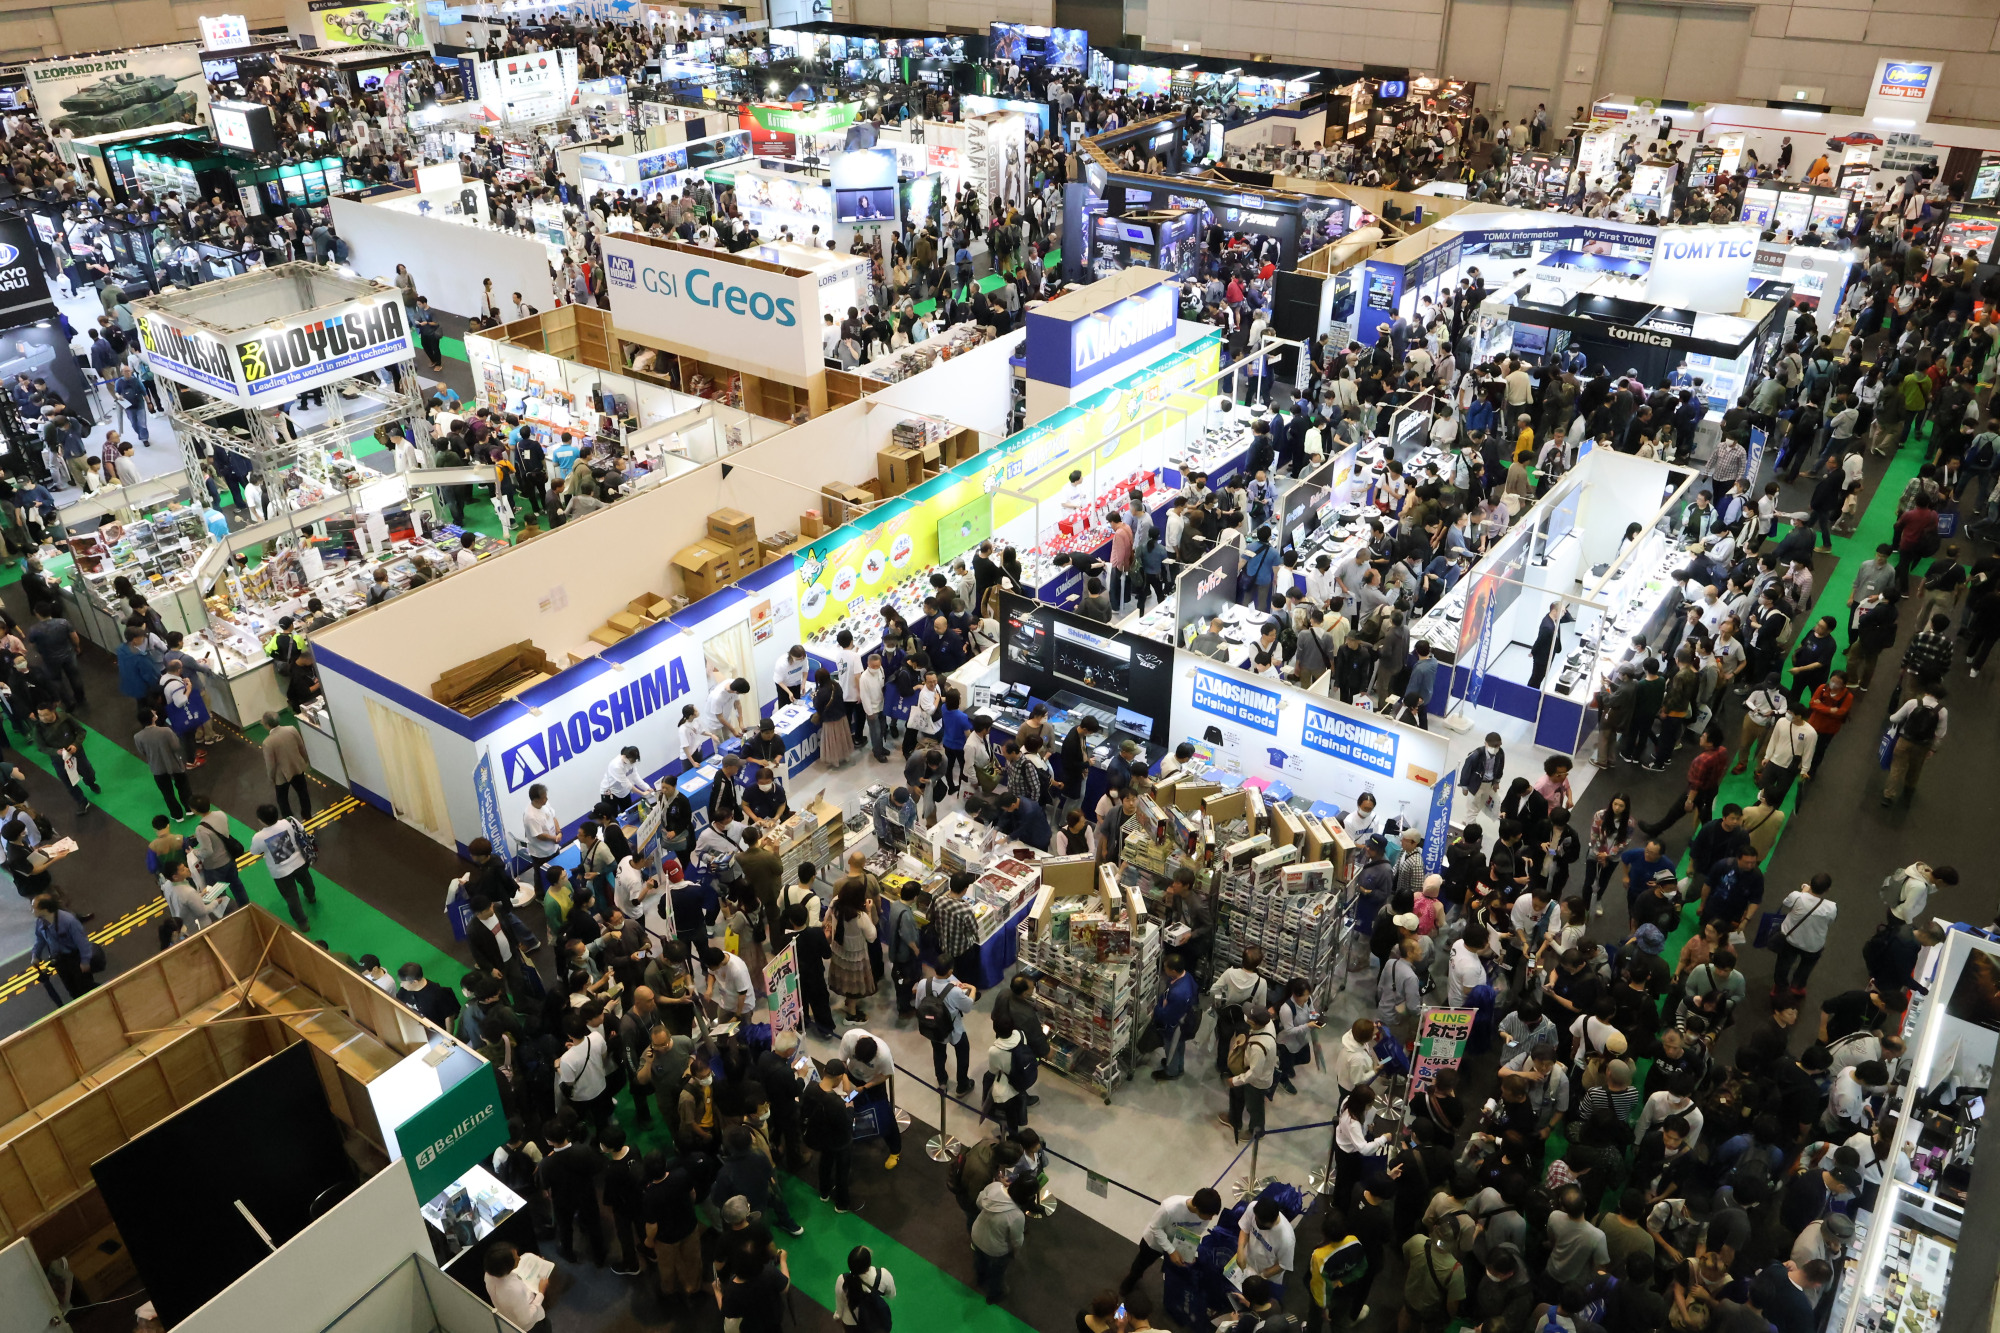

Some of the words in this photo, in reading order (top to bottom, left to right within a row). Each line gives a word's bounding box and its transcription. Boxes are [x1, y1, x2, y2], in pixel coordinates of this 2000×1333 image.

[215, 37, 243, 46] TAMIYA
[34, 63, 95, 80] LEOPARD
[95, 63, 103, 71] 2
[105, 60, 128, 71] A7V
[510, 73, 549, 85] PLATZ
[1881, 86, 1906, 97] Hobby
[1906, 88, 1923, 98] kits
[1483, 232, 1511, 241] TOMIX
[1512, 230, 1559, 240] Information
[1584, 230, 1597, 239] My
[1599, 231, 1620, 242] First
[1623, 236, 1652, 246] TOMIX
[610, 267, 633, 281] HOBBY
[642, 267, 678, 298] GSI
[685, 268, 797, 328] Creos
[1100, 288, 1174, 359] AOSHIMA
[1648, 319, 1692, 335] tomica
[267, 300, 405, 376] DOYUSHA
[1607, 325, 1672, 348] tomica
[150, 320, 236, 384] DOYUSHA
[252, 374, 287, 394] Leading
[287, 372, 302, 384] the
[302, 366, 325, 382] world
[326, 362, 335, 373] in
[335, 354, 360, 370] model
[361, 342, 405, 364] technology.
[1067, 627, 1111, 649] ShinMay
[1212, 675, 1278, 715] AOSHIMA
[548, 656, 691, 771] AOSHIMA
[1194, 691, 1237, 717] Original
[1239, 704, 1276, 730] Goods
[1324, 713, 1394, 756] AOSHIMA
[1304, 730, 1350, 756] Original
[1352, 744, 1393, 771] Goods
[1433, 1013, 1468, 1024] LINE
[1426, 1022, 1469, 1041] 友だち
[1424, 1057, 1458, 1066] になると
[434, 1103, 493, 1154] BellFine
